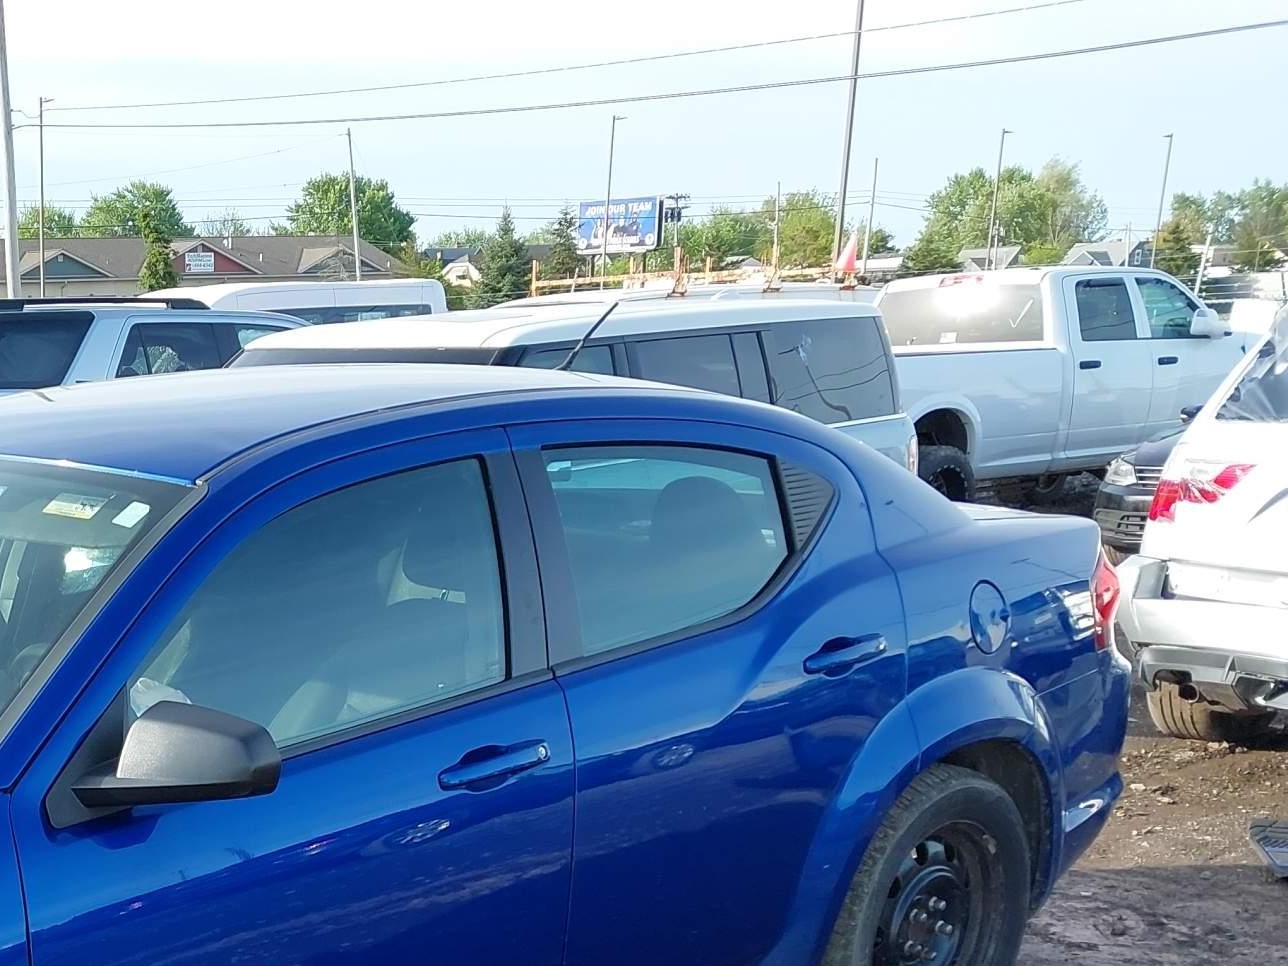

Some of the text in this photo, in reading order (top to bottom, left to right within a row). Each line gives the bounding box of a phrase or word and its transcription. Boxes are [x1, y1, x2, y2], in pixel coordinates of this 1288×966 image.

[585, 201, 653, 216] JOIN OUR TEAM
